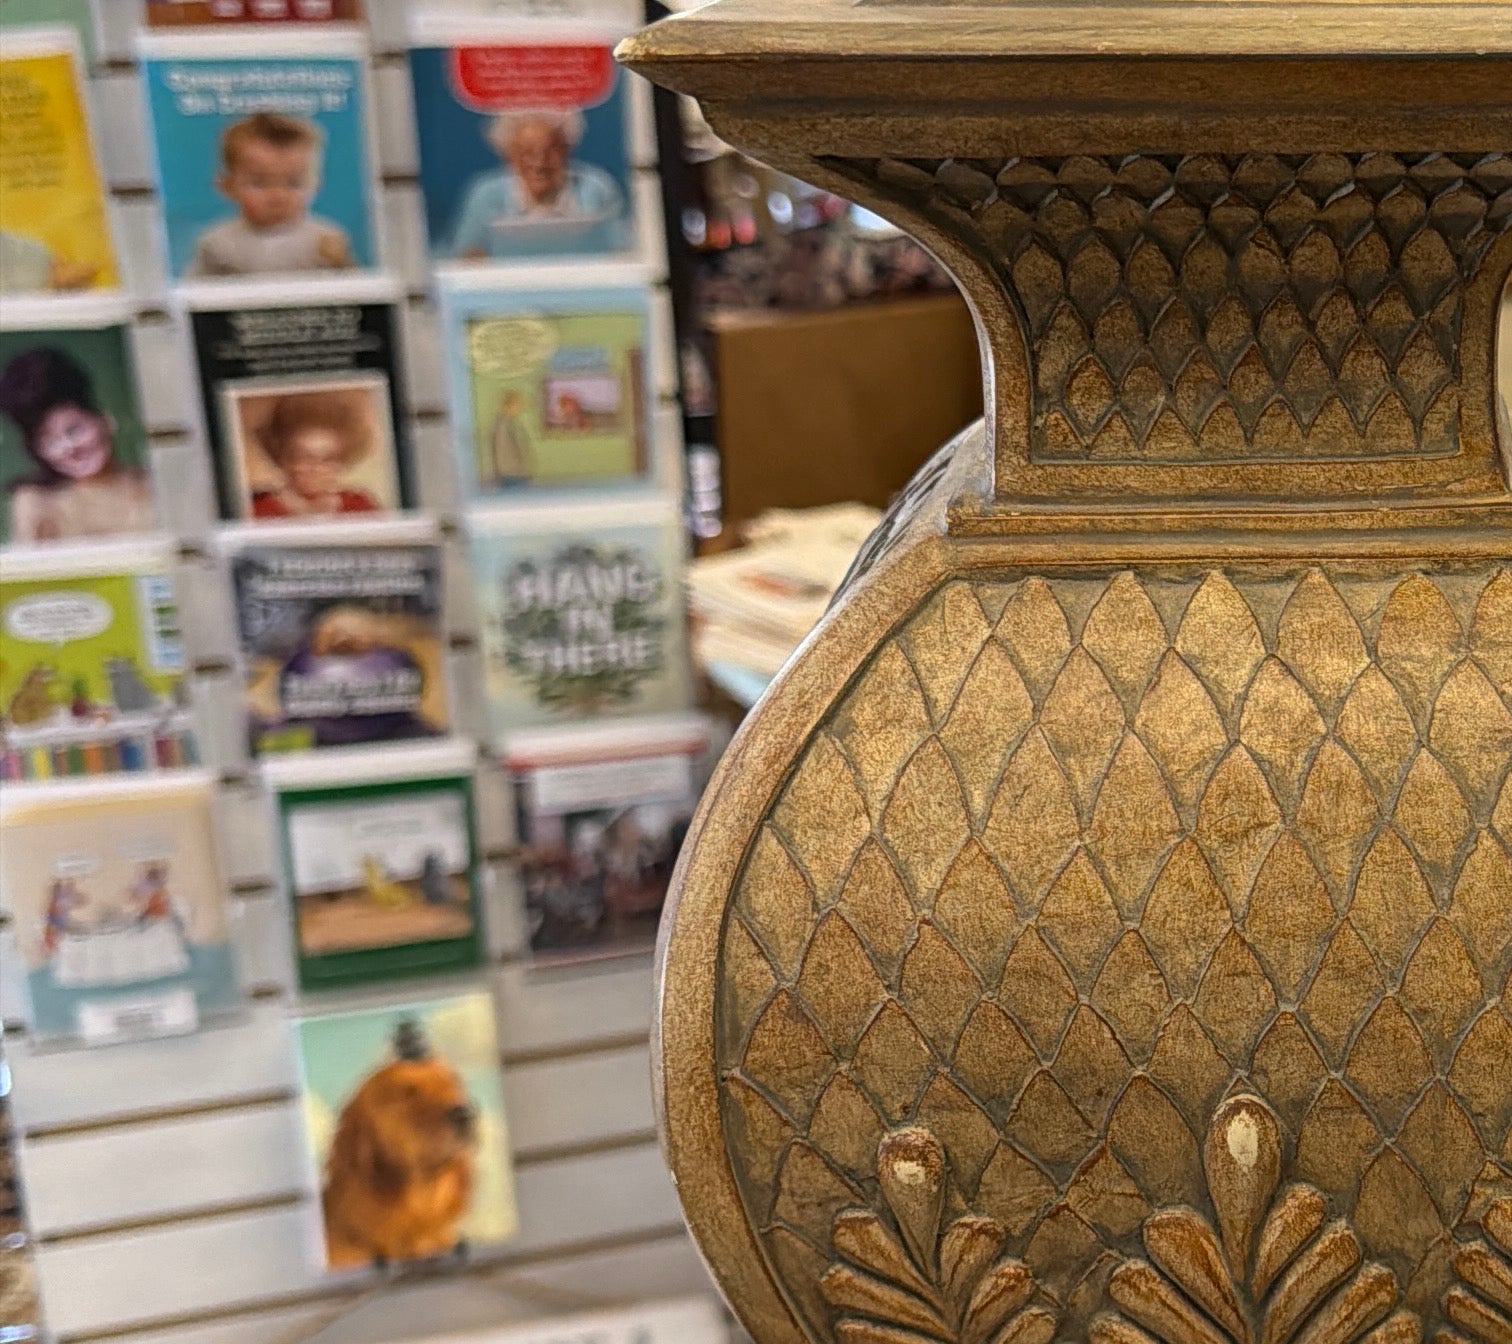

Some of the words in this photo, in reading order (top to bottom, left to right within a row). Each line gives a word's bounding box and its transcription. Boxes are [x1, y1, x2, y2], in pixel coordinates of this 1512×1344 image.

[512, 562, 655, 609] HANG
[565, 606, 612, 642] IN
[520, 636, 656, 676] THERE
